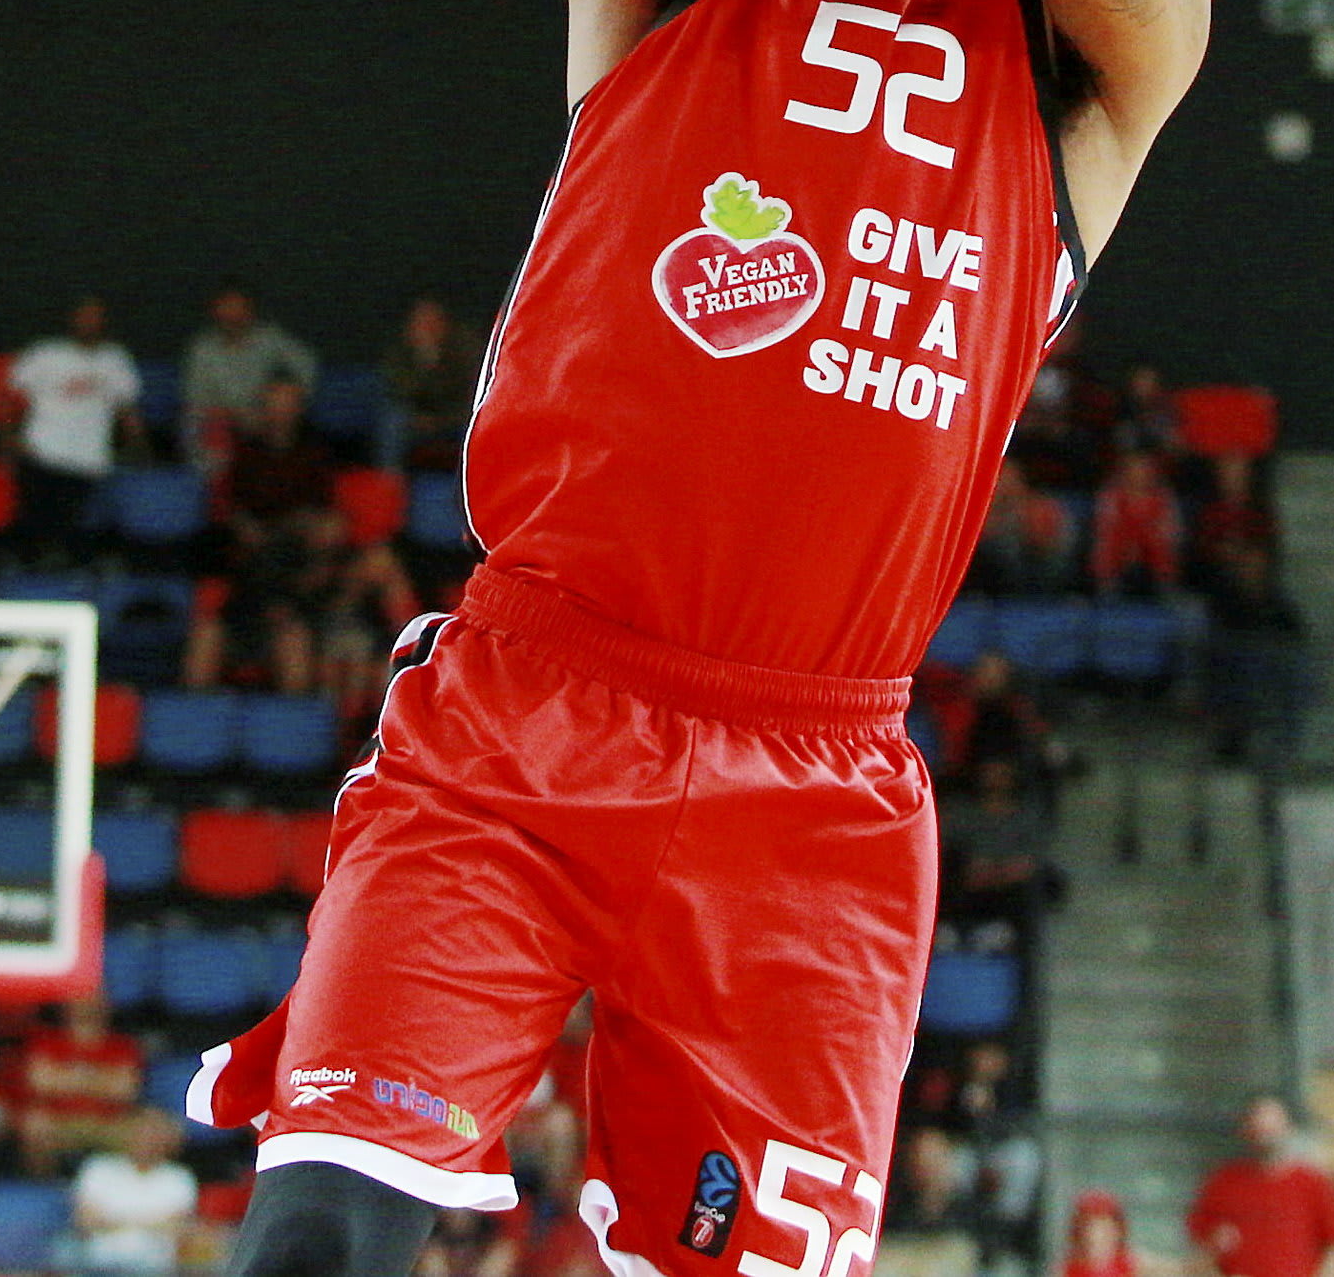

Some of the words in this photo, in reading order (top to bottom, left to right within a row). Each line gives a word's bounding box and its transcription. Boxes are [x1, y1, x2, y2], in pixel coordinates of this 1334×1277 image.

[784, 0, 965, 170] 52
[847, 208, 983, 291] GIVE
[841, 276, 911, 339] IT
[918, 299, 959, 359] A
[802, 338, 967, 430] SHOT
[289, 1067, 356, 1085] Reebok
[737, 1139, 884, 1277] 52
